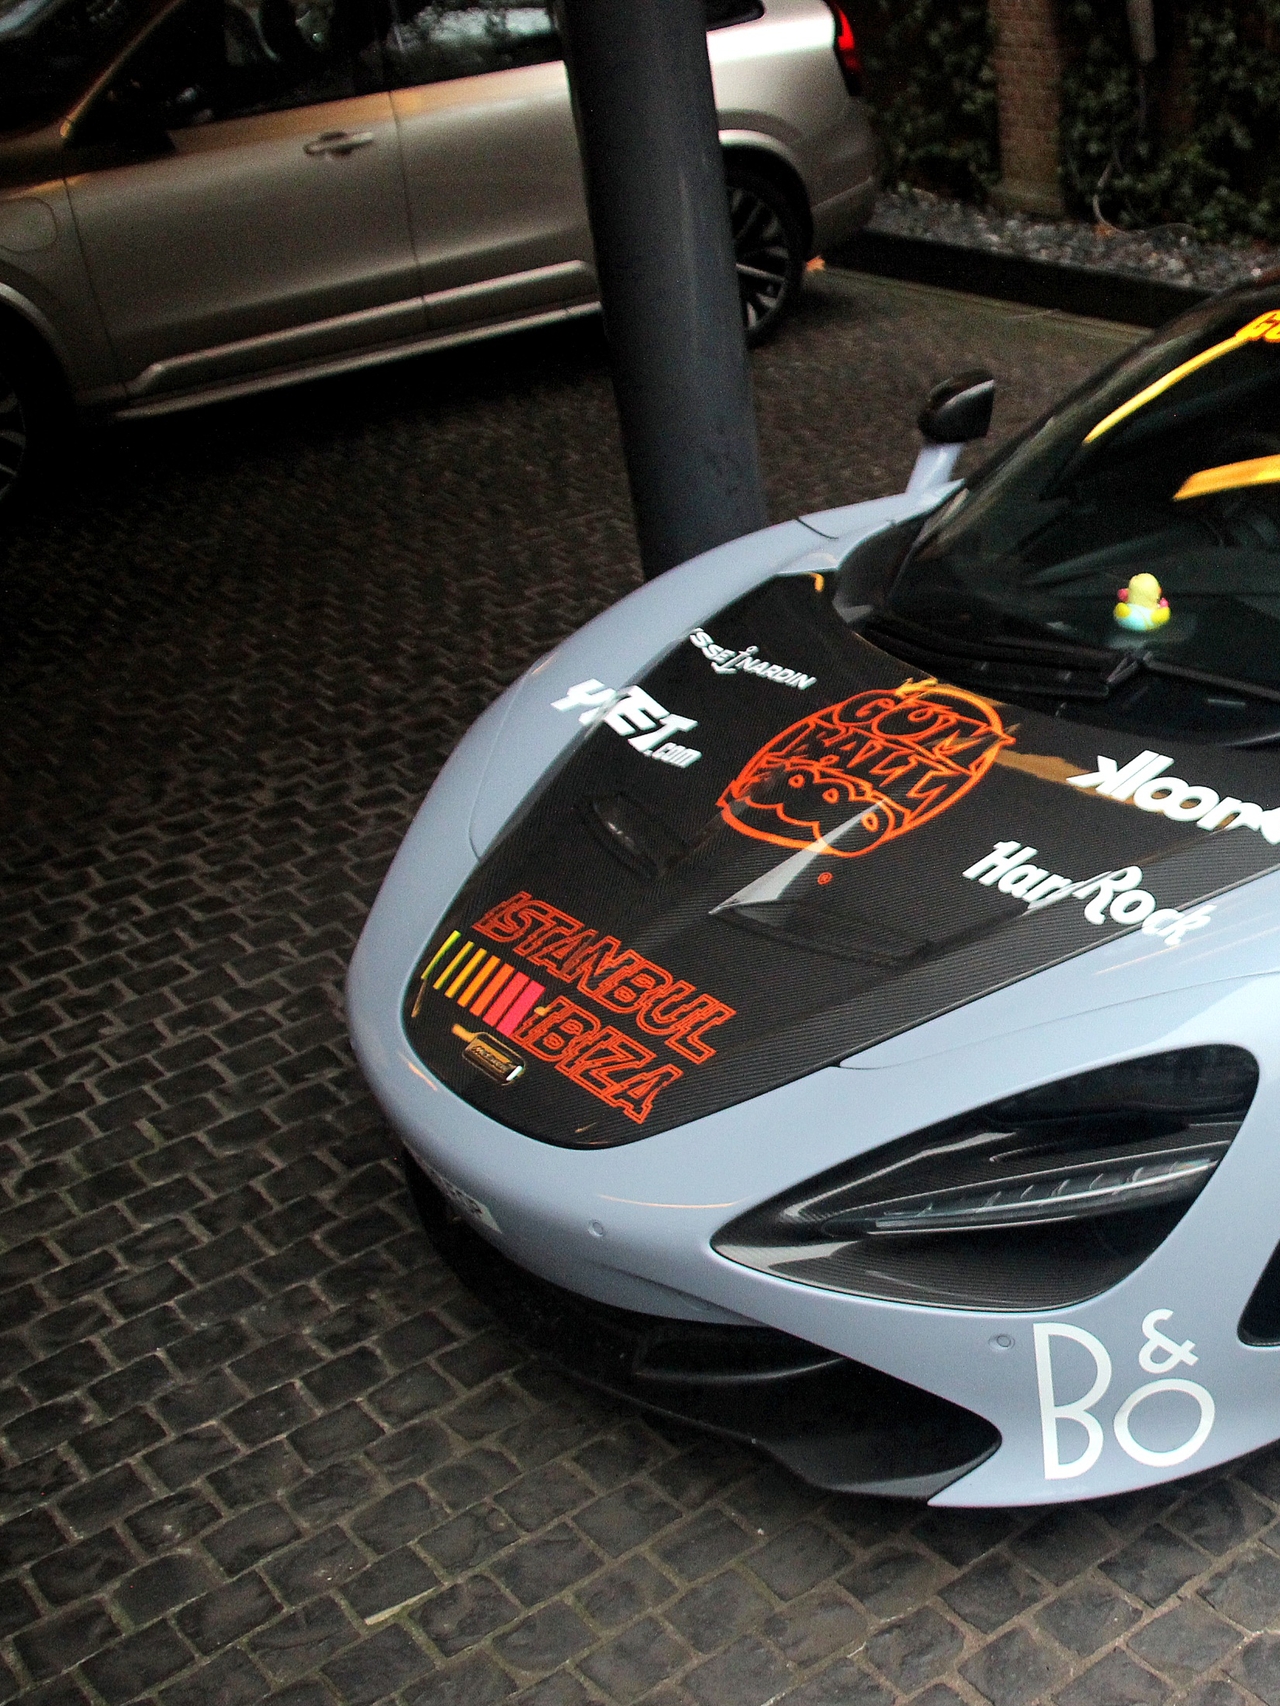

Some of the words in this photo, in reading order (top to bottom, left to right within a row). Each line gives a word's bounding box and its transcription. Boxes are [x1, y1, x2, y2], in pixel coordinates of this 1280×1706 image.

[739, 657, 817, 690] NARDIN
[1073, 865, 1218, 946] Rock
[473, 891, 736, 1065] ISTANBUL
[509, 995, 684, 1124] IBIZA
